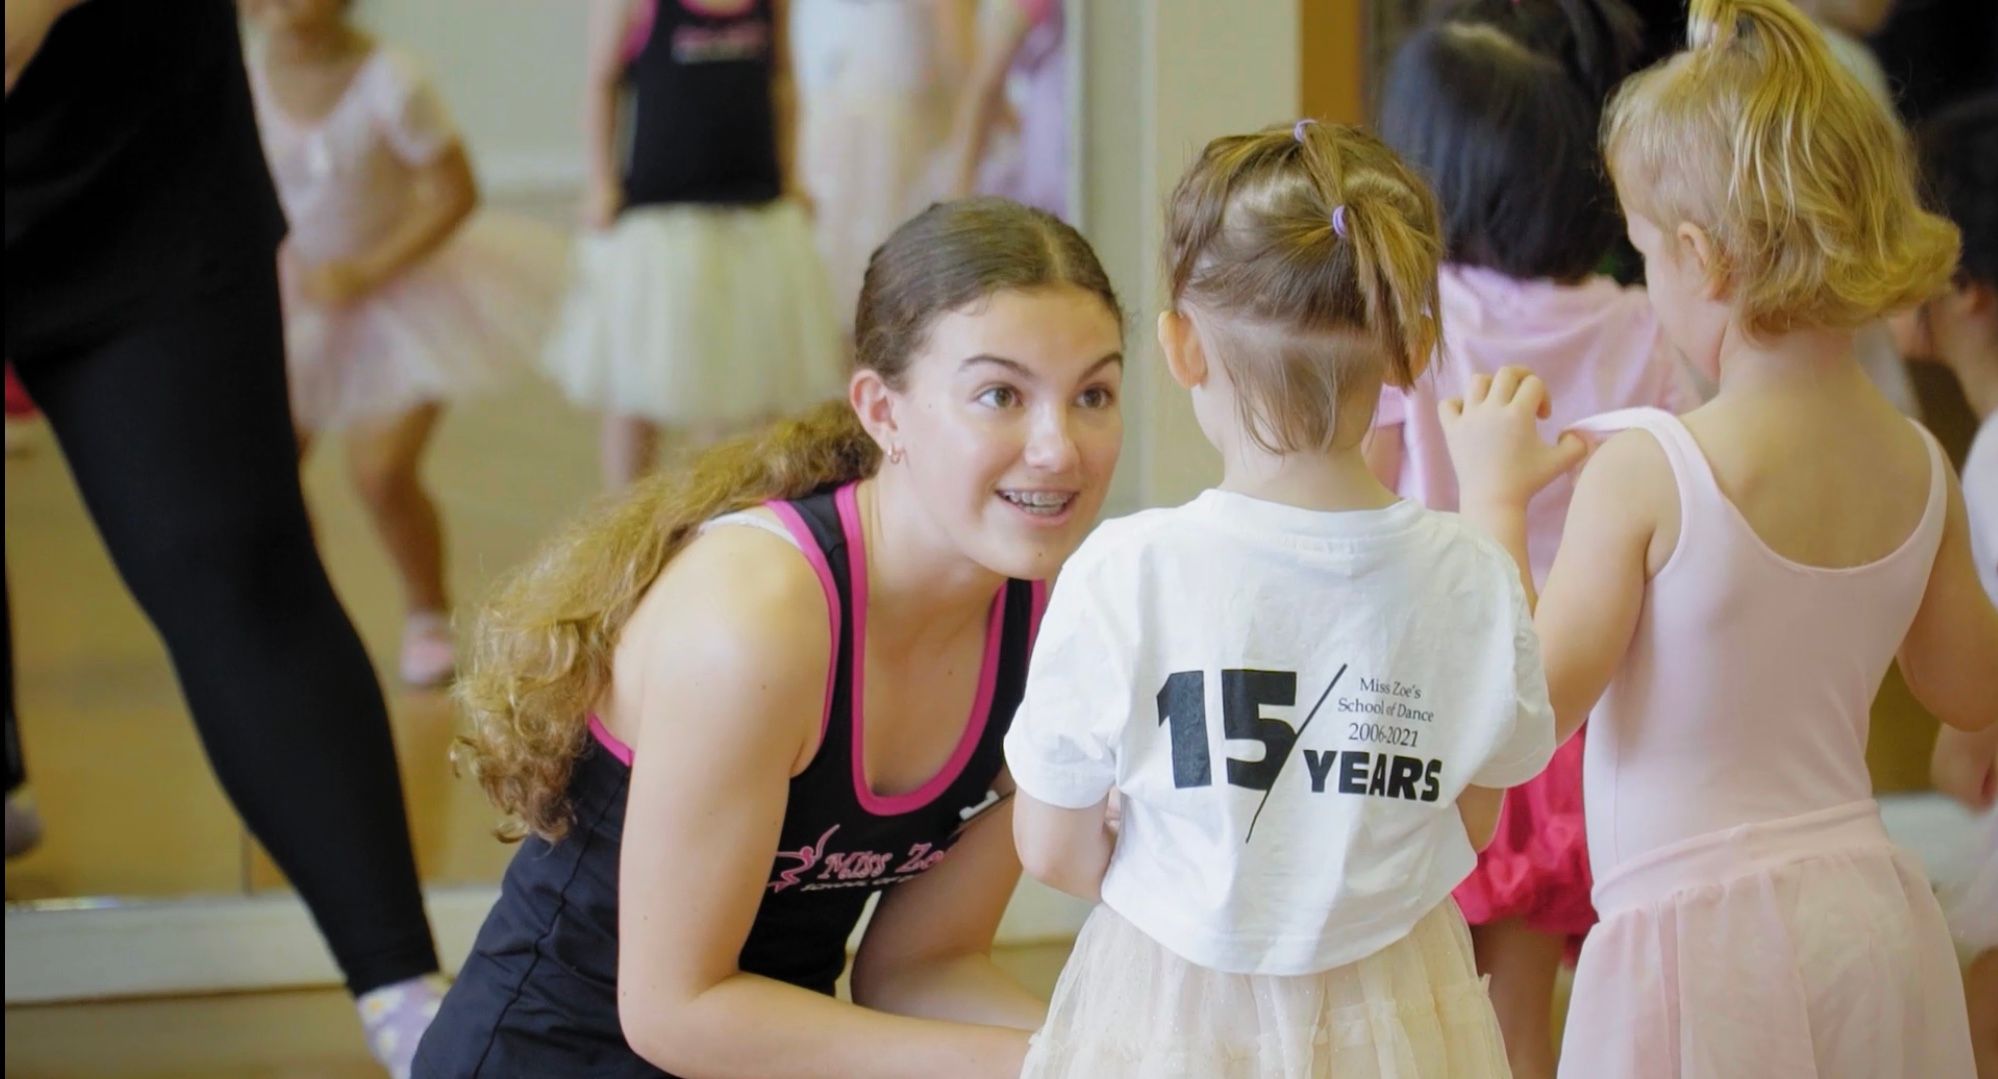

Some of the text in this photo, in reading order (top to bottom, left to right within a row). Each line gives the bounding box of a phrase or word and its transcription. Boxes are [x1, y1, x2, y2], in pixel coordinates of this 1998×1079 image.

[1360, 677, 1422, 699] Miss Zoe's
[1337, 697, 1434, 722] School of Dance
[1157, 669, 1297, 790] 15
[1348, 722, 1418, 748] 2006-2021
[1303, 749, 1442, 802] YEARS
